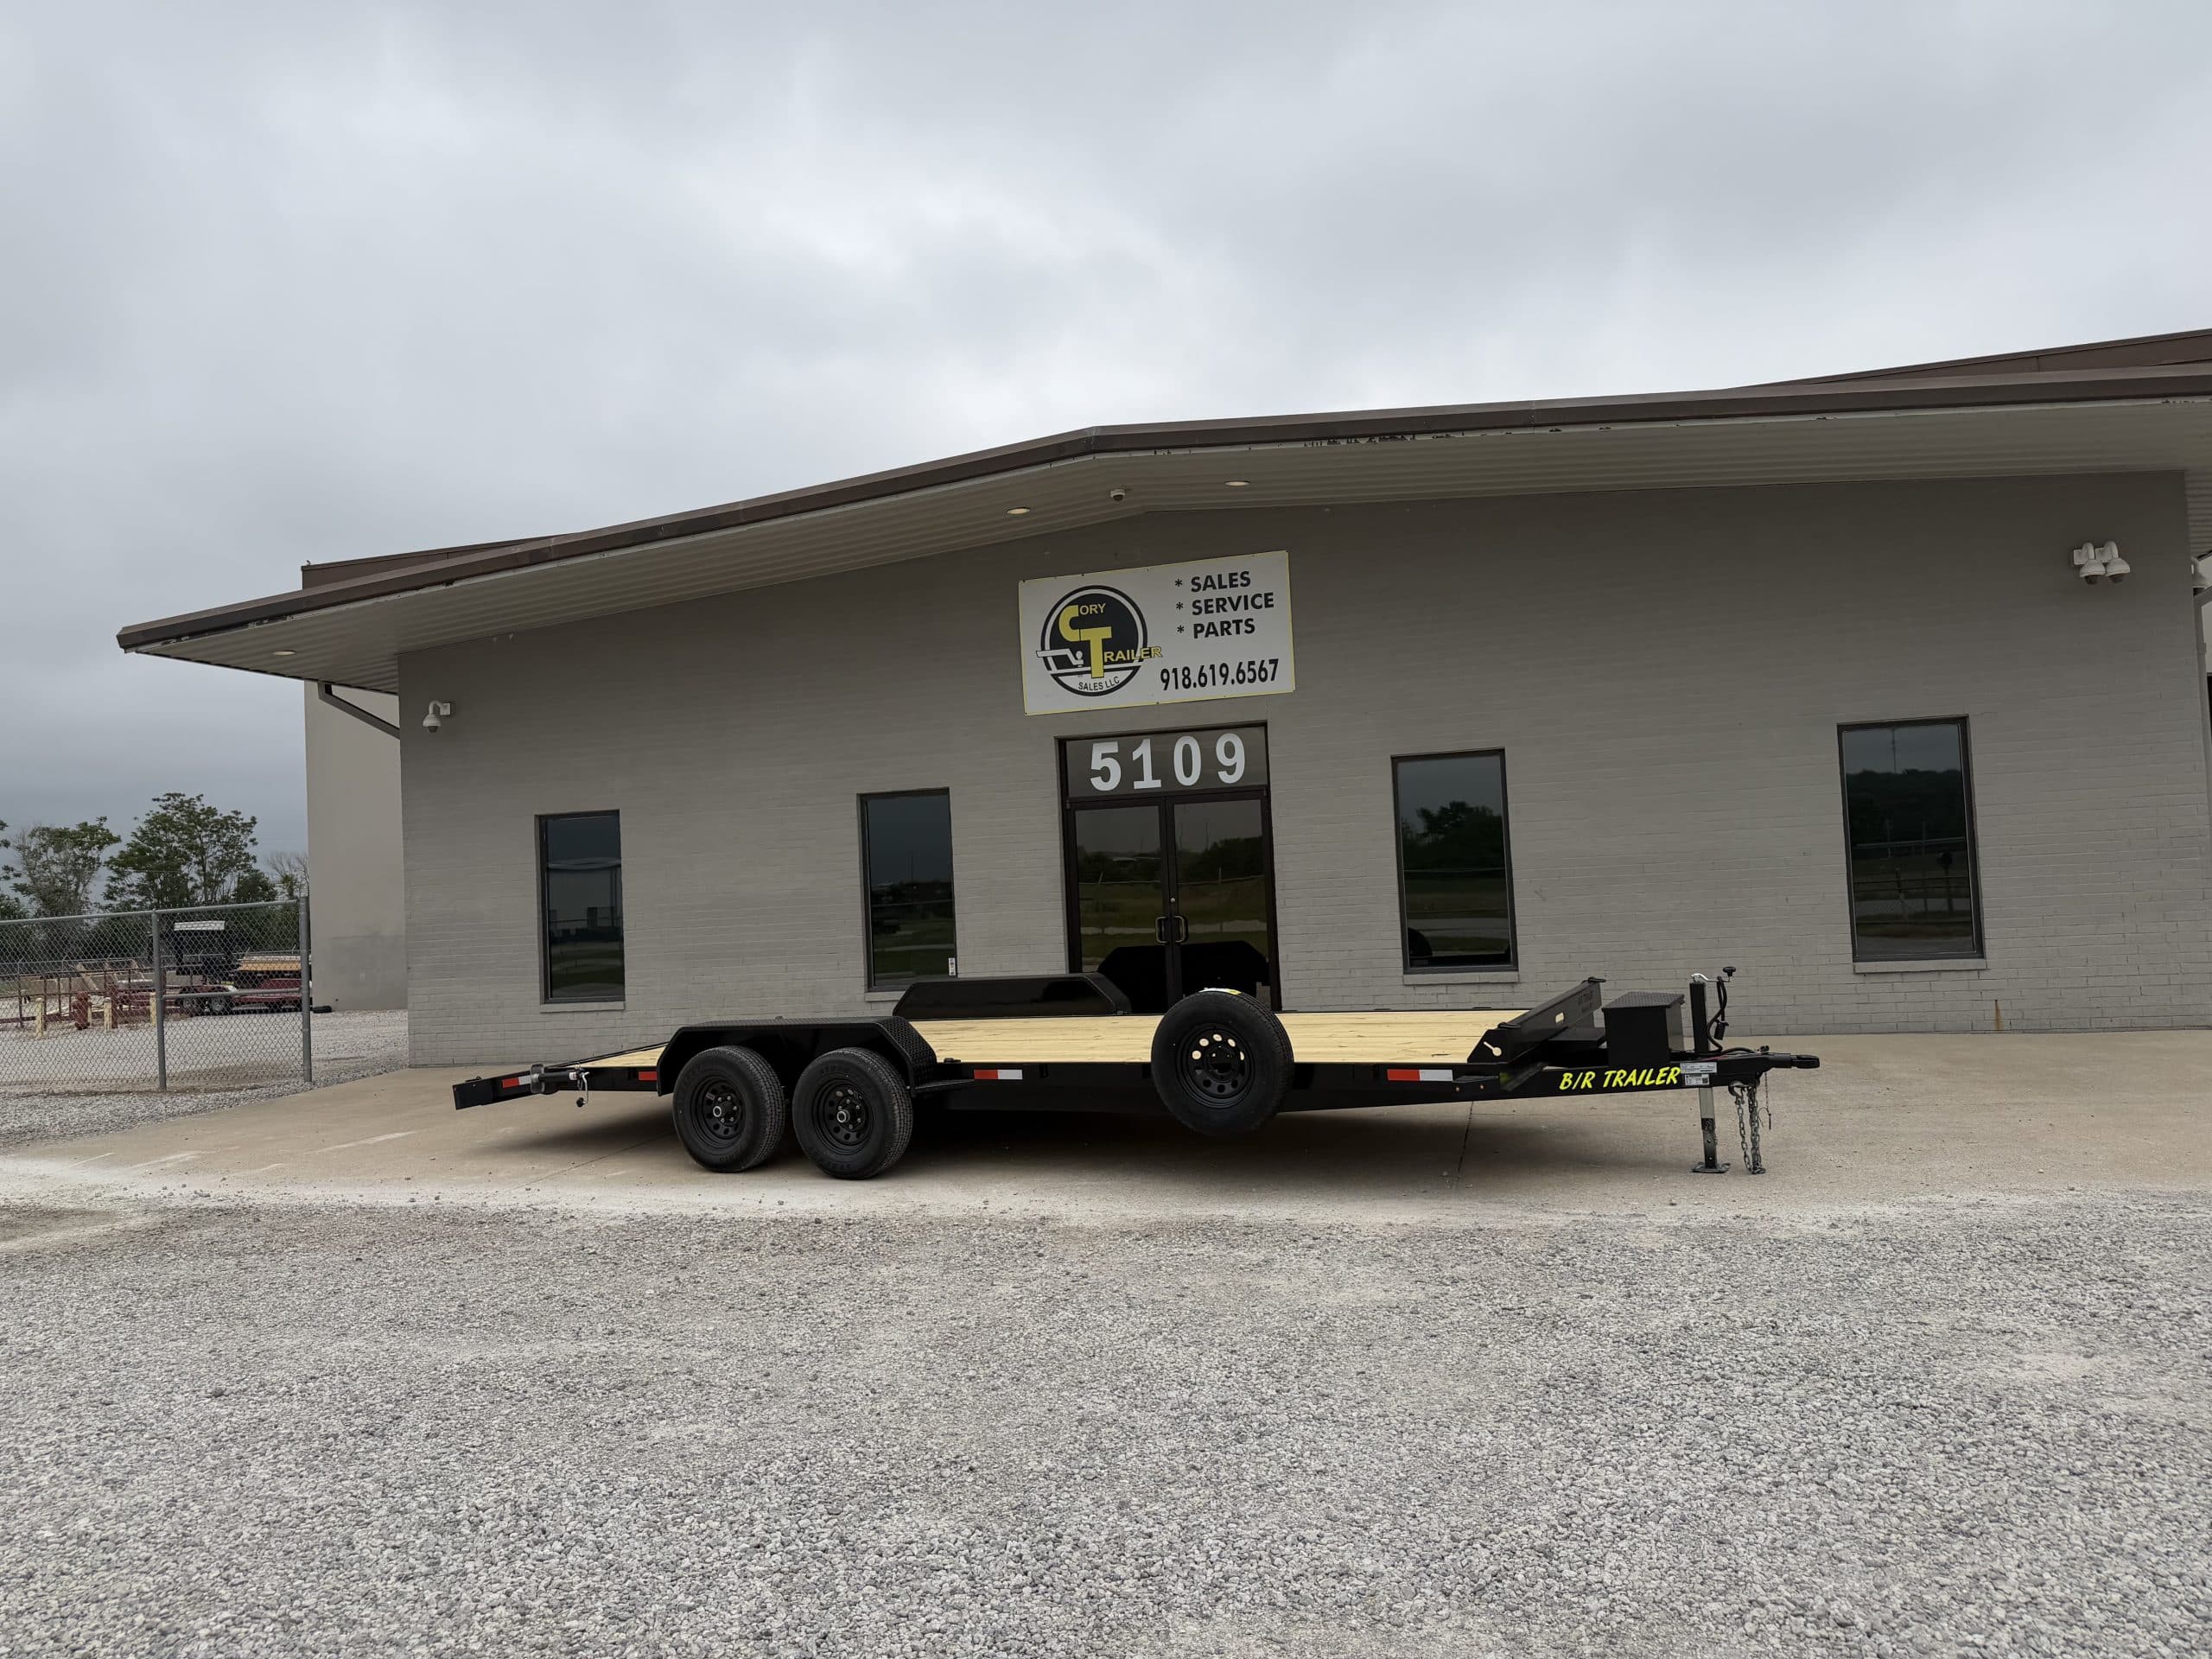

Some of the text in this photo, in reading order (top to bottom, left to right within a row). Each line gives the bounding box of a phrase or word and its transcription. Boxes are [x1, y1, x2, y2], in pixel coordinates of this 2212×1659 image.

[1191, 570, 1251, 593] SALES
[1192, 592, 1274, 616] SERVICE
[1193, 618, 1255, 639] PARTS
[1077, 676, 1121, 691] SALES LLC
[1160, 658, 1279, 691] 918.619.6567
[1090, 733, 1246, 791] 5109
[1559, 1071, 1596, 1090] B/R
[1603, 1066, 1681, 1088] TRAILER
